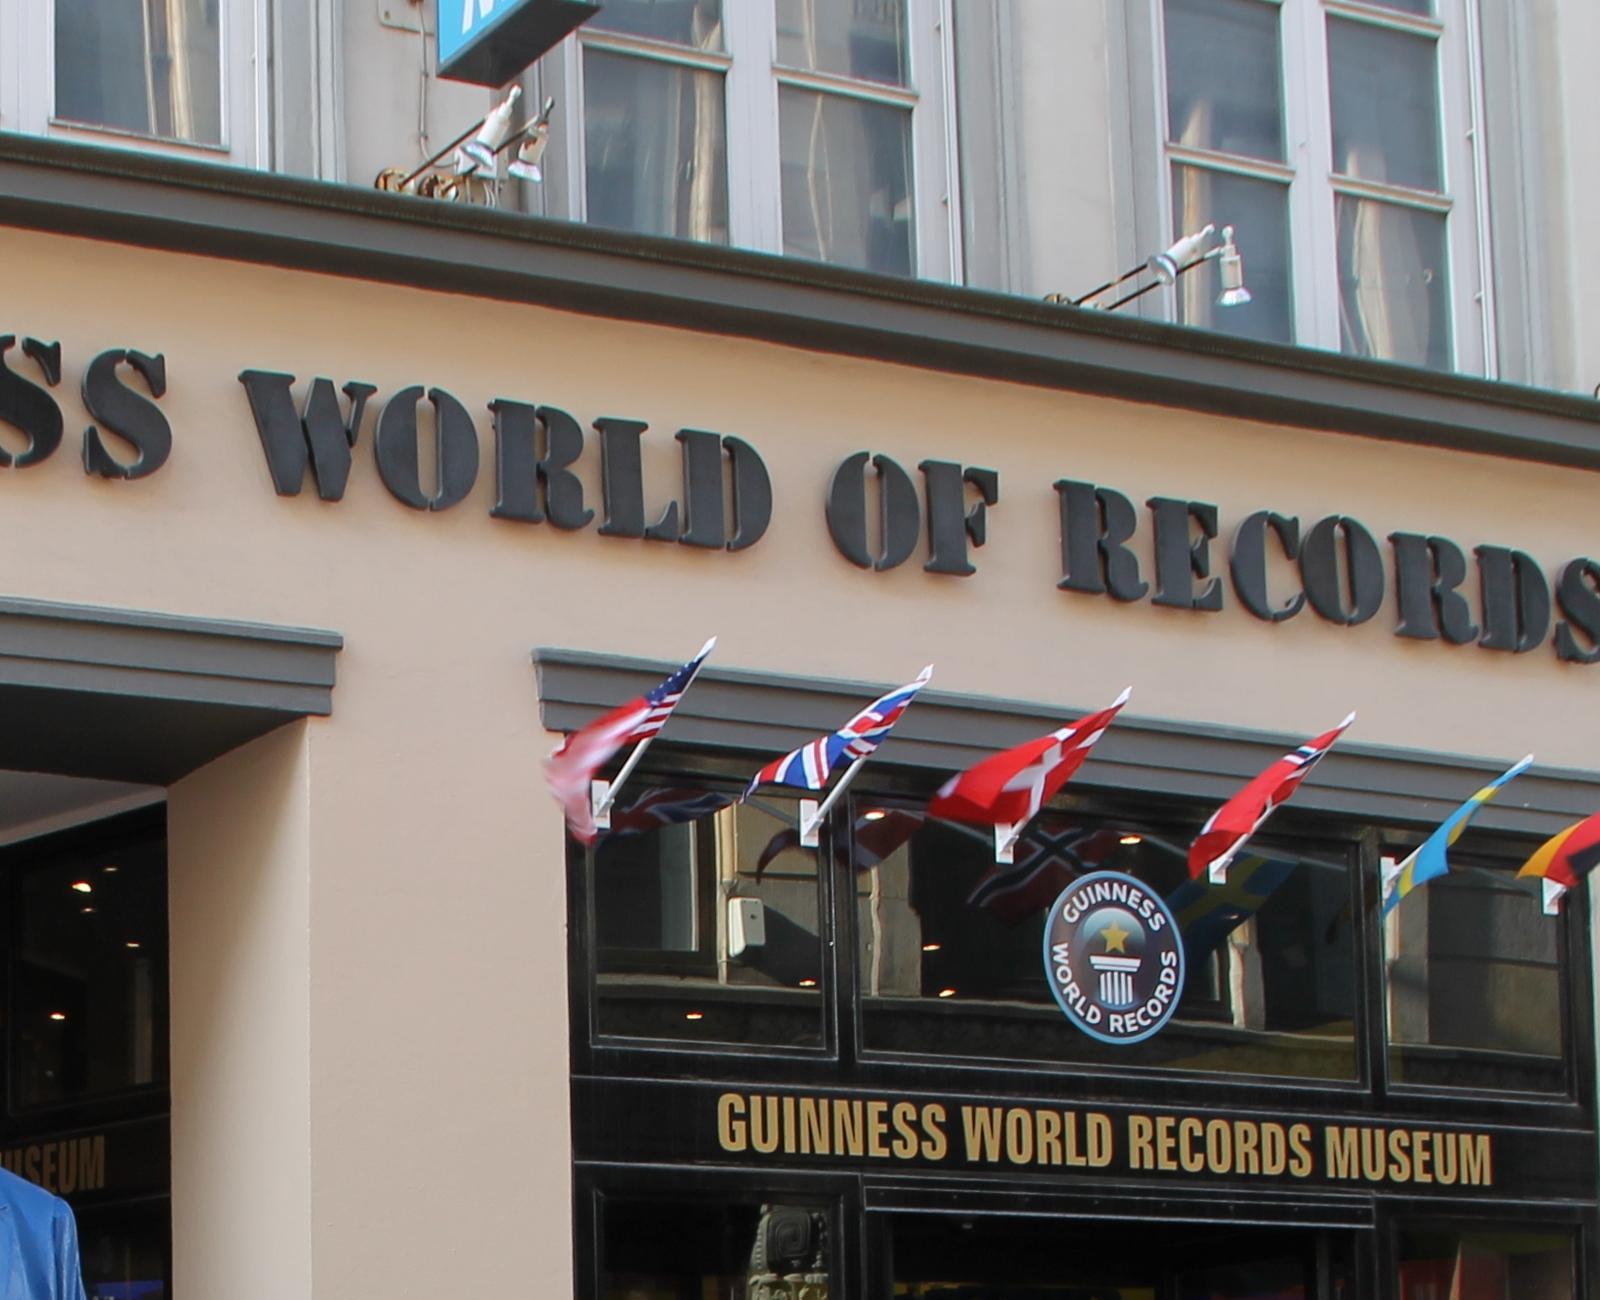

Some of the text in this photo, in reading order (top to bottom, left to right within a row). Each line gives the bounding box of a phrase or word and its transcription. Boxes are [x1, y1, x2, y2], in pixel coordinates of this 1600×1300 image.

[238, 368, 774, 553] WORLD
[826, 451, 998, 577] OF
[1053, 478, 1600, 665] RECORDS
[1063, 882, 1166, 932] GUINNESS
[1053, 943, 1177, 1033] WORLD RECORDS
[717, 1092, 1493, 1187] GUINNESS WORLD RECORDS MUSEUM
